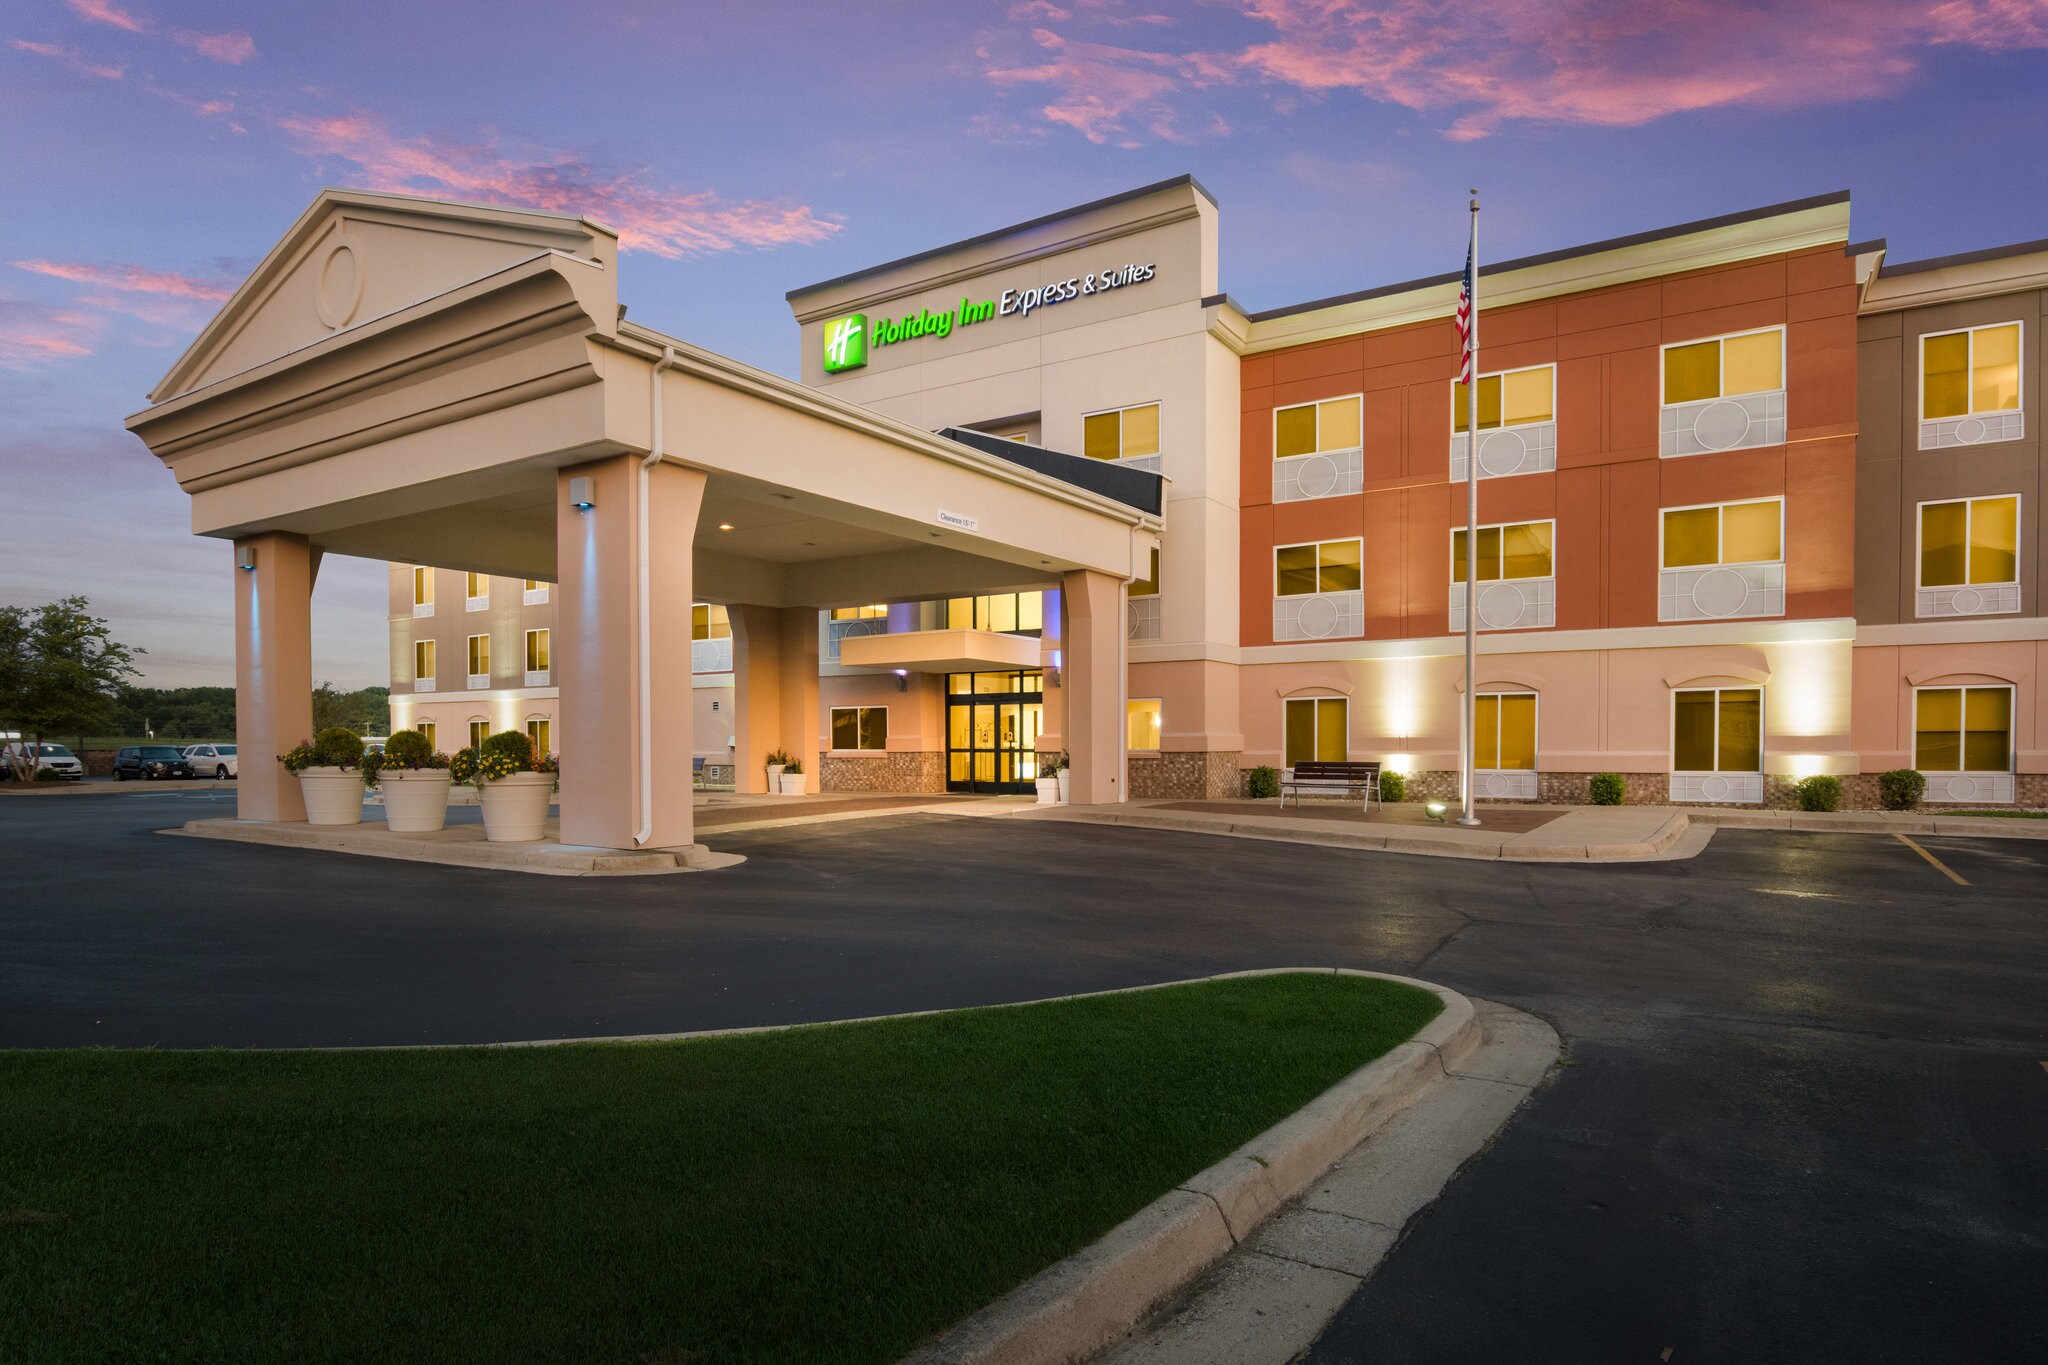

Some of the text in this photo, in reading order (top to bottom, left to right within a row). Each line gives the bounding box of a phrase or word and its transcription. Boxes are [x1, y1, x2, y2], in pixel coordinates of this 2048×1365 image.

[872, 263, 1155, 347] Holiday Inn Express & Suites
[940, 512, 962, 524] Clearance
